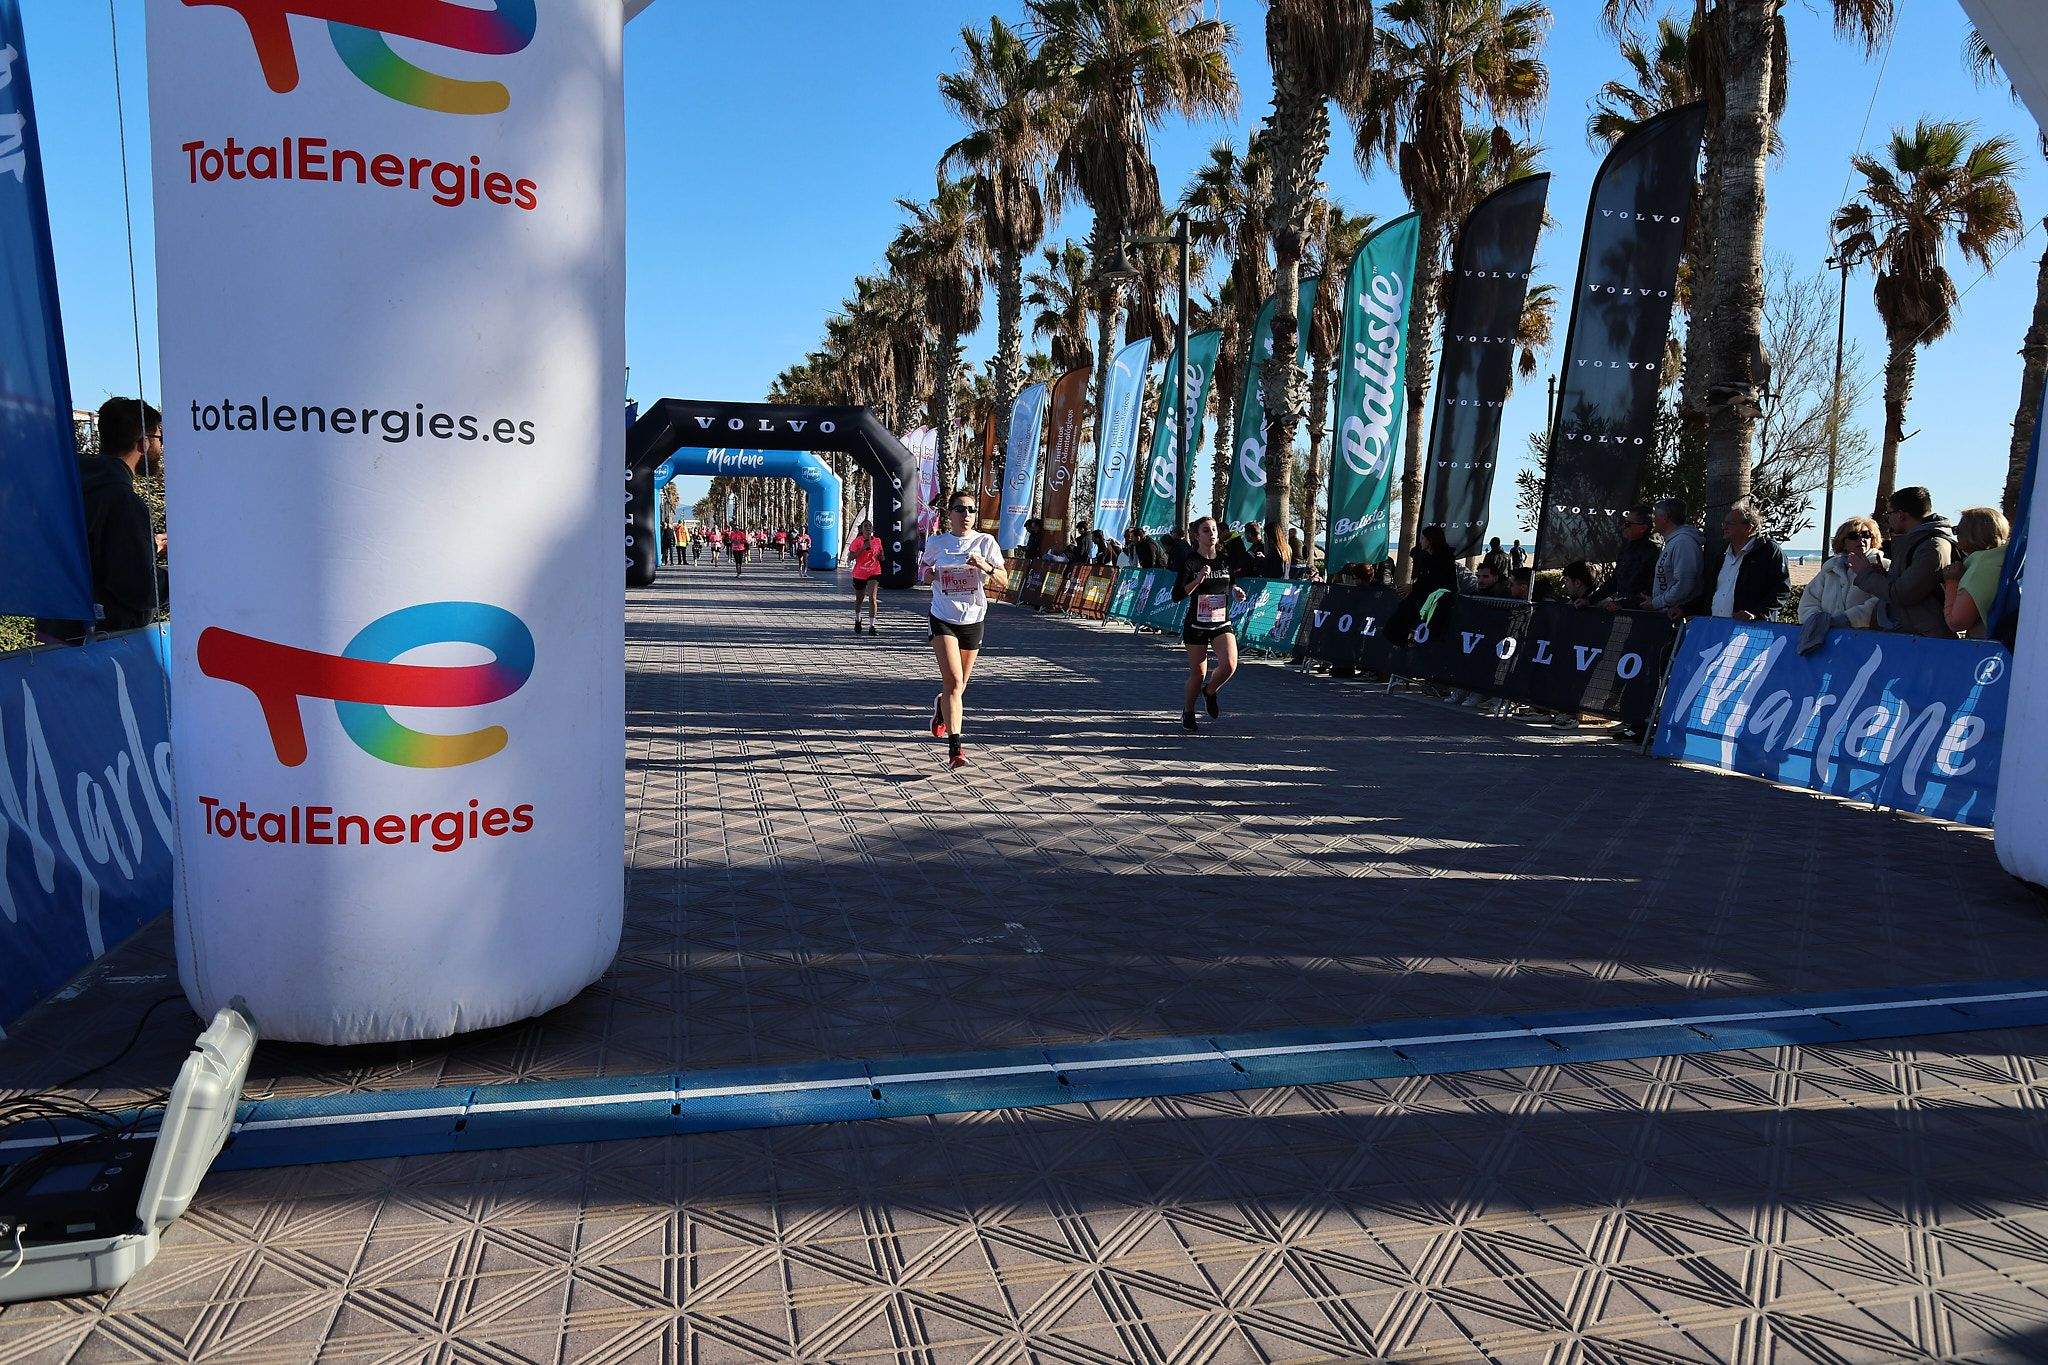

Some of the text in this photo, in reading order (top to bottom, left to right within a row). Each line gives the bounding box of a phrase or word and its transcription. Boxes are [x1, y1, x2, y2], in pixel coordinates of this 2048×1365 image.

[182, 137, 538, 211] TotalEnergies
[1602, 209, 1681, 223] VOLVO
[1464, 270, 1529, 280] VOLVO
[1588, 284, 1668, 298] VOLVO
[1455, 335, 1516, 345] VOLVO
[1577, 359, 1655, 370] VOLVO
[1341, 270, 1404, 482] Batiste
[1447, 398, 1503, 408] VOLVO
[190, 395, 536, 445] totalenergies.es
[694, 416, 836, 434] VOLVO
[1566, 433, 1643, 445] VOLVO
[706, 447, 764, 472] Marlene
[1438, 461, 1492, 470] VOLVO
[892, 477, 902, 575] VOLVO
[1313, 609, 1430, 644] VOLO
[1460, 631, 1643, 680] VOLVO
[1674, 633, 1985, 796] Marlene
[199, 795, 535, 853] TotalEnergies
